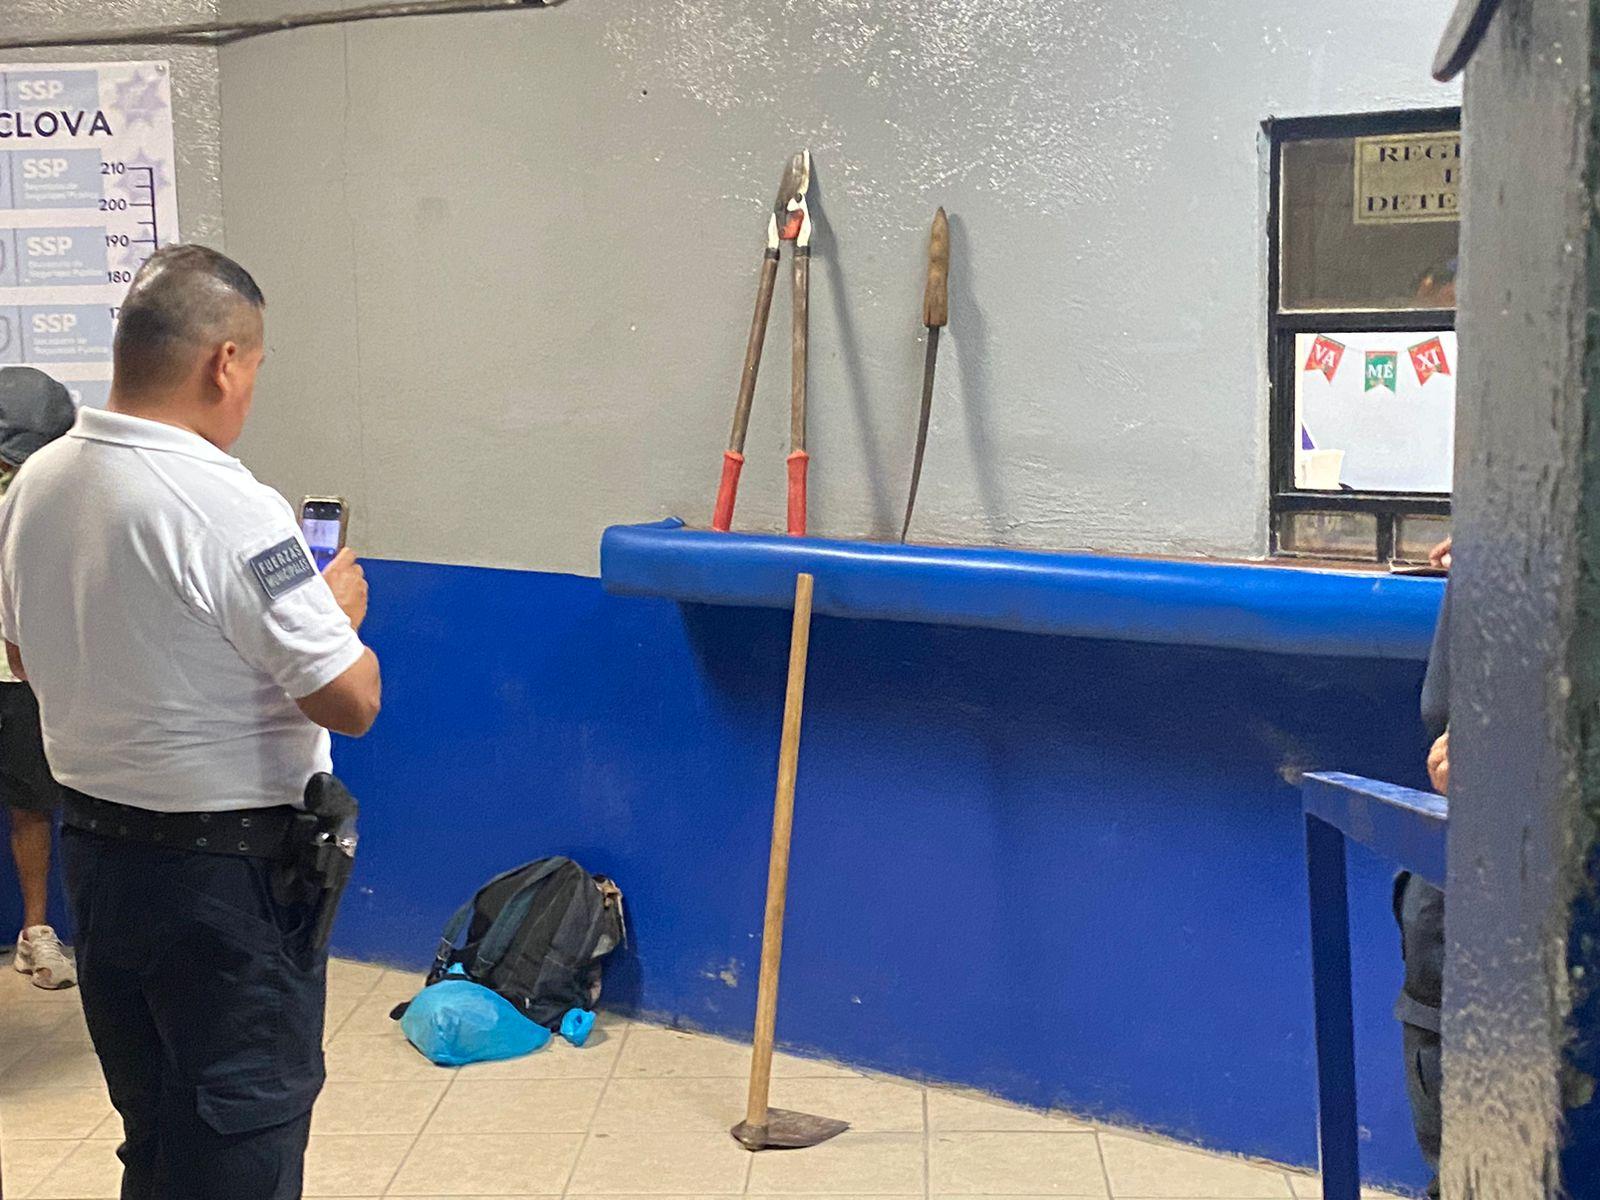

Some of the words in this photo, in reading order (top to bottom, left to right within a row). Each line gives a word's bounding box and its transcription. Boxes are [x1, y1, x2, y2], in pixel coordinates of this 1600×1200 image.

[18, 80, 64, 100] SSP
[0, 110, 113, 138] CLOVA
[23, 158, 69, 179] SSP
[101, 162, 126, 175] 210
[99, 199, 127, 211] 200
[27, 236, 73, 256] SSP
[105, 235, 129, 247] 190
[108, 271, 131, 283] 180
[32, 313, 77, 333] SSP
[1313, 343, 1336, 367] VA
[1416, 348, 1441, 370] XI
[258, 543, 303, 575] FUERZAS
